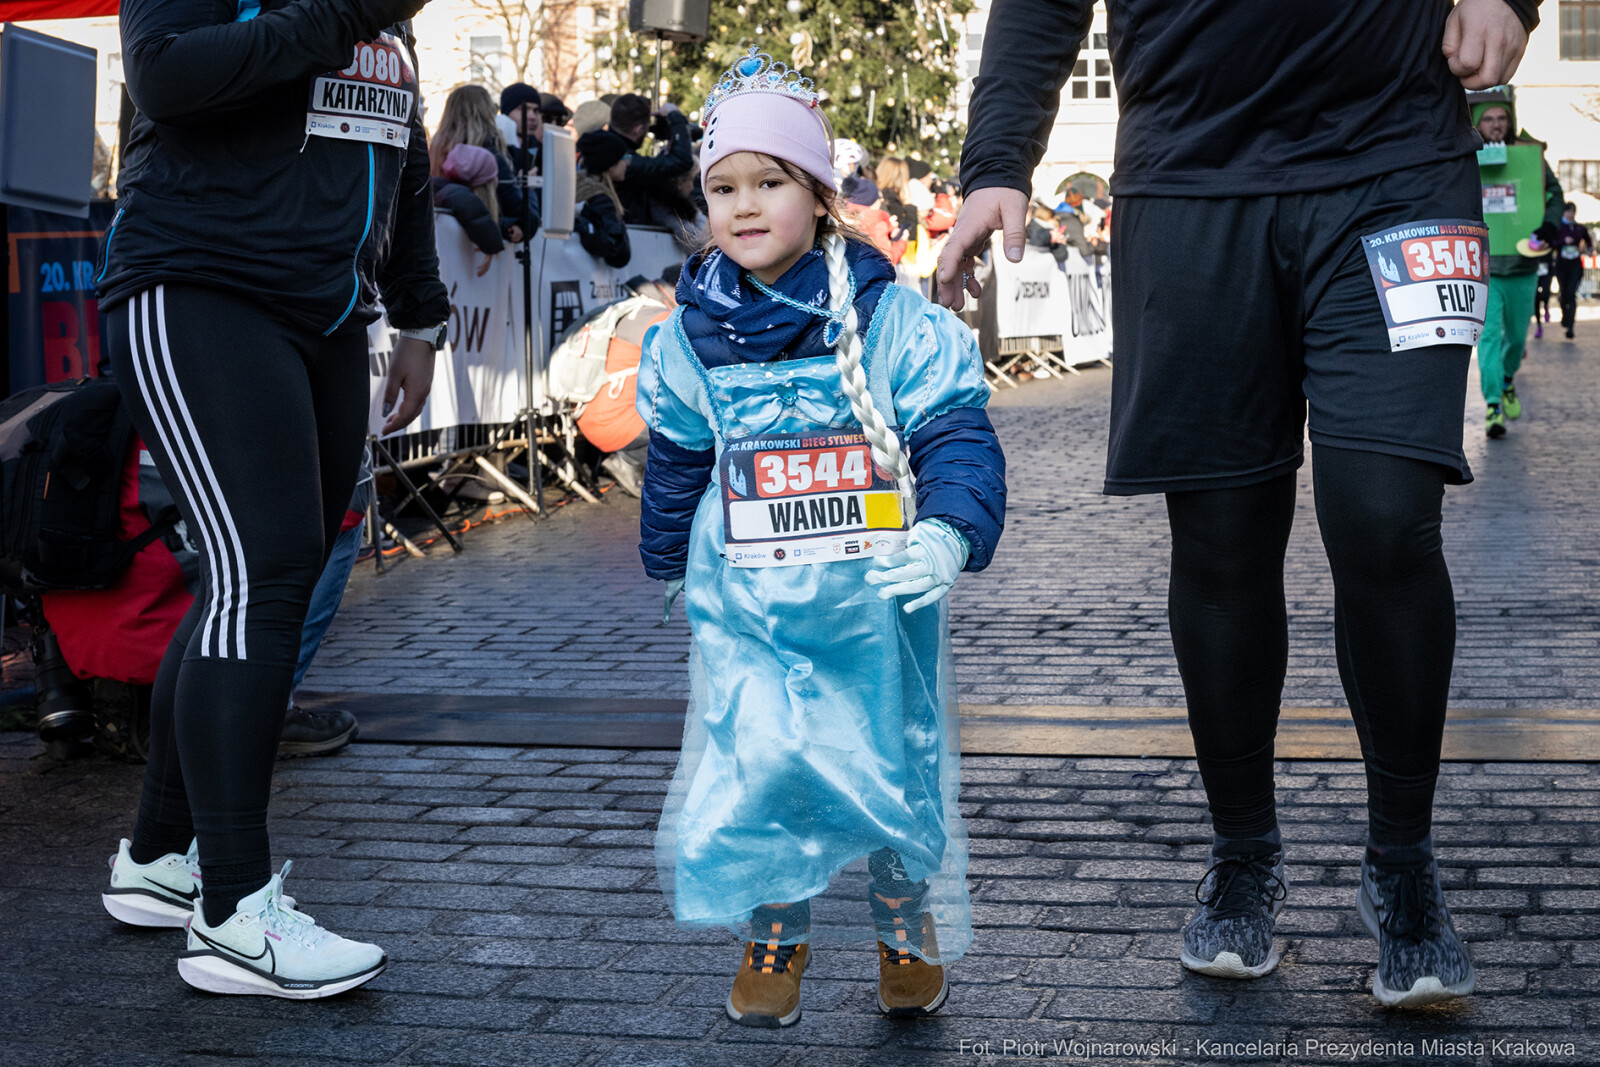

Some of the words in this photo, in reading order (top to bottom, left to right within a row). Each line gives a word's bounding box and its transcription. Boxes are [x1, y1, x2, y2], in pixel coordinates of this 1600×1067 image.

[322, 81, 408, 119] KATARZYNA
[1370, 238, 1385, 248] 20.
[1384, 225, 1440, 243] KRAKOWSKI
[1440, 225, 1458, 235] BIEG
[1408, 240, 1481, 278] 3543
[40, 261, 71, 293] 20.
[1436, 284, 1476, 313] FILIP
[728, 442, 740, 452] 20.
[741, 438, 801, 451] KRAKOWSKI
[802, 436, 826, 448] BIEG
[760, 450, 867, 494] 3544
[768, 495, 863, 534] WANDA
